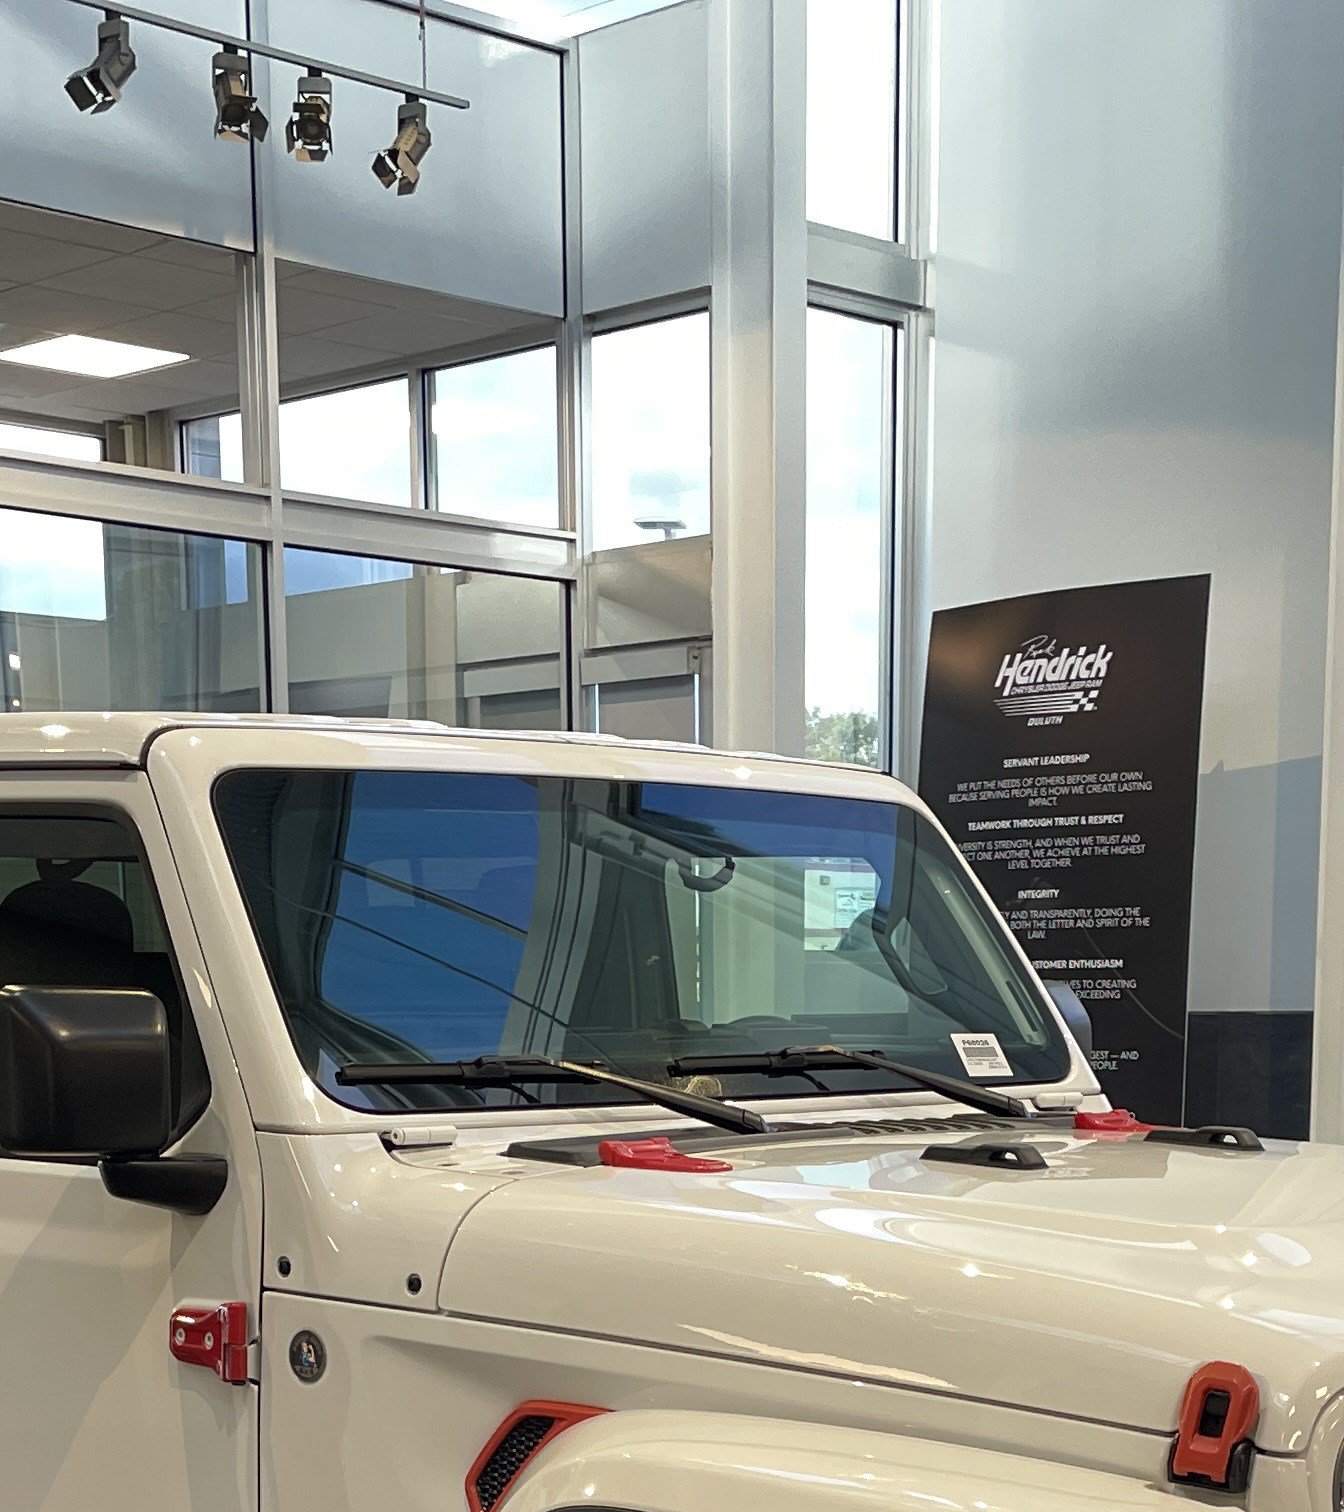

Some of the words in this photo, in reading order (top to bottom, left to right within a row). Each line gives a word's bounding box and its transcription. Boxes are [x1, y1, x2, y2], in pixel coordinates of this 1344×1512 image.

[994, 645, 1113, 696] Hendrick
[1027, 716, 1063, 726] DULUTH
[1003, 757, 1039, 768] SERVANT
[1040, 754, 1090, 766] LEADERSHIP
[957, 783, 968, 792] WE
[969, 781, 982, 790] PUT
[983, 780, 996, 790] THE
[997, 779, 1021, 789] NEEDS
[1022, 777, 1034, 787] OF
[1035, 775, 1065, 786] OTHERS
[1067, 774, 1098, 784] BEFORE
[1099, 772, 1118, 782] OUR
[1120, 771, 1143, 781] OWN
[949, 792, 977, 803] BECAUSE
[979, 790, 1010, 801] SERVING
[1011, 788, 1038, 798] PEOPLE
[1040, 787, 1047, 796] IS
[1048, 786, 1070, 796] HOW
[1071, 785, 1084, 794] WE
[1086, 783, 1116, 793] CREATE
[1118, 781, 1153, 792] LASTING
[968, 820, 1011, 831] TEAMWORK
[1013, 818, 1053, 828] THROUGH
[1054, 816, 1079, 826] TRUST
[1081, 816, 1086, 825] &
[1088, 814, 1124, 825] RESPECT
[1034, 838, 1053, 848] AND
[1054, 837, 1079, 847] WHEN
[1081, 836, 1094, 846] WE
[1096, 835, 1120, 845] TRUST
[1121, 834, 1141, 844] AND
[977, 851, 993, 860] ONE
[1032, 848, 1045, 858] WE
[1046, 847, 1081, 857] ACHIEVE
[1081, 846, 1092, 855] AT
[1094, 845, 1110, 855] THE
[1111, 844, 1146, 855] HIGHEST
[1008, 860, 1029, 870] LEVEL
[1018, 889, 1059, 899] INTEGRITY
[1011, 910, 1028, 919] AND
[1094, 908, 1123, 917] DOING
[1125, 907, 1141, 917] THE
[1010, 920, 1031, 929] BOTH
[1033, 920, 1047, 929] THE
[1048, 919, 1074, 929] LETTER
[1076, 918, 1094, 928] AND
[1096, 918, 1119, 928] SPIRIT
[1120, 917, 1133, 927] OF
[1135, 916, 1151, 927] THE
[1069, 959, 1123, 969] ENTHUSIASM
[1082, 980, 1093, 989] TO
[1095, 979, 1137, 989] CREATING
[1120, 1051, 1140, 1060] AND
